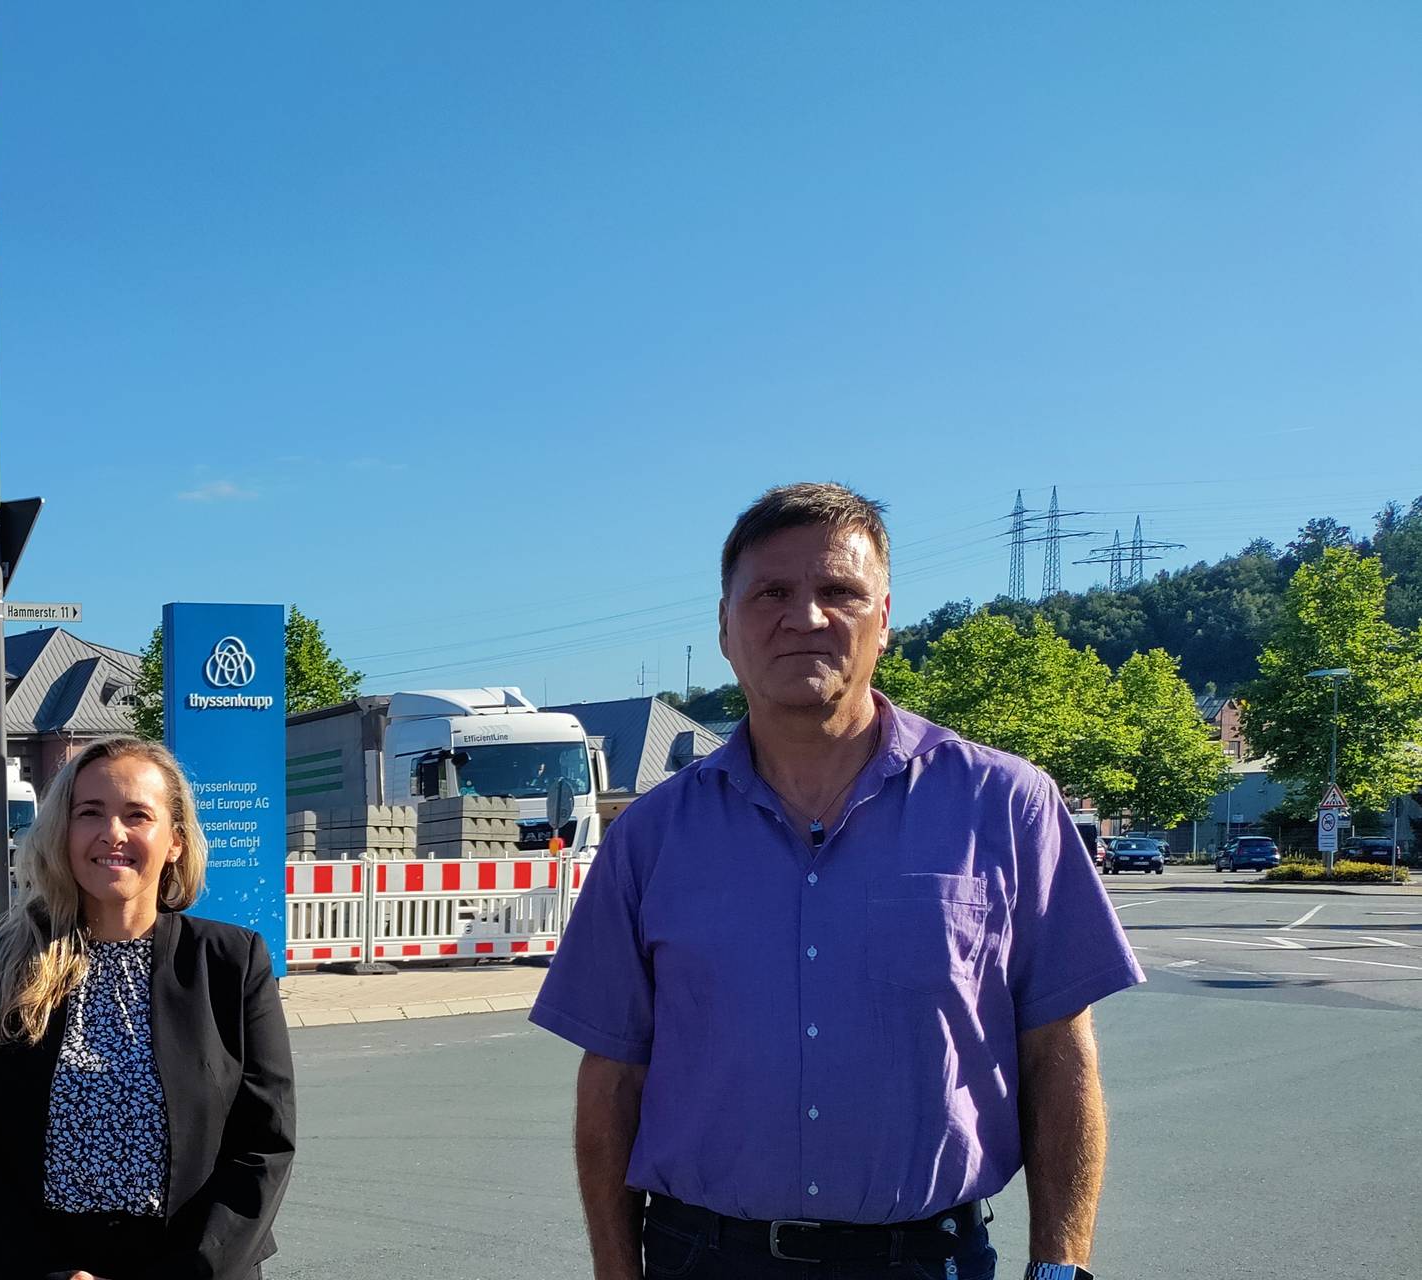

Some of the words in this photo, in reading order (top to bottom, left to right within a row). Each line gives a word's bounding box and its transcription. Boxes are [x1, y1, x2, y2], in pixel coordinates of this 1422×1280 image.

[7, 605, 57, 618] Hammerstr.
[60, 606, 69, 618] 11
[189, 692, 273, 710] thyssenkrupp
[463, 733, 509, 743] EfficientLine
[195, 798, 215, 810] teel
[217, 798, 253, 811] Europe
[254, 797, 270, 809] AG
[201, 819, 258, 832] yssenkrupp
[208, 837, 227, 849] ulte
[229, 836, 260, 848] GmbH
[520, 832, 552, 842] AN
[207, 858, 246, 868] merstraße
